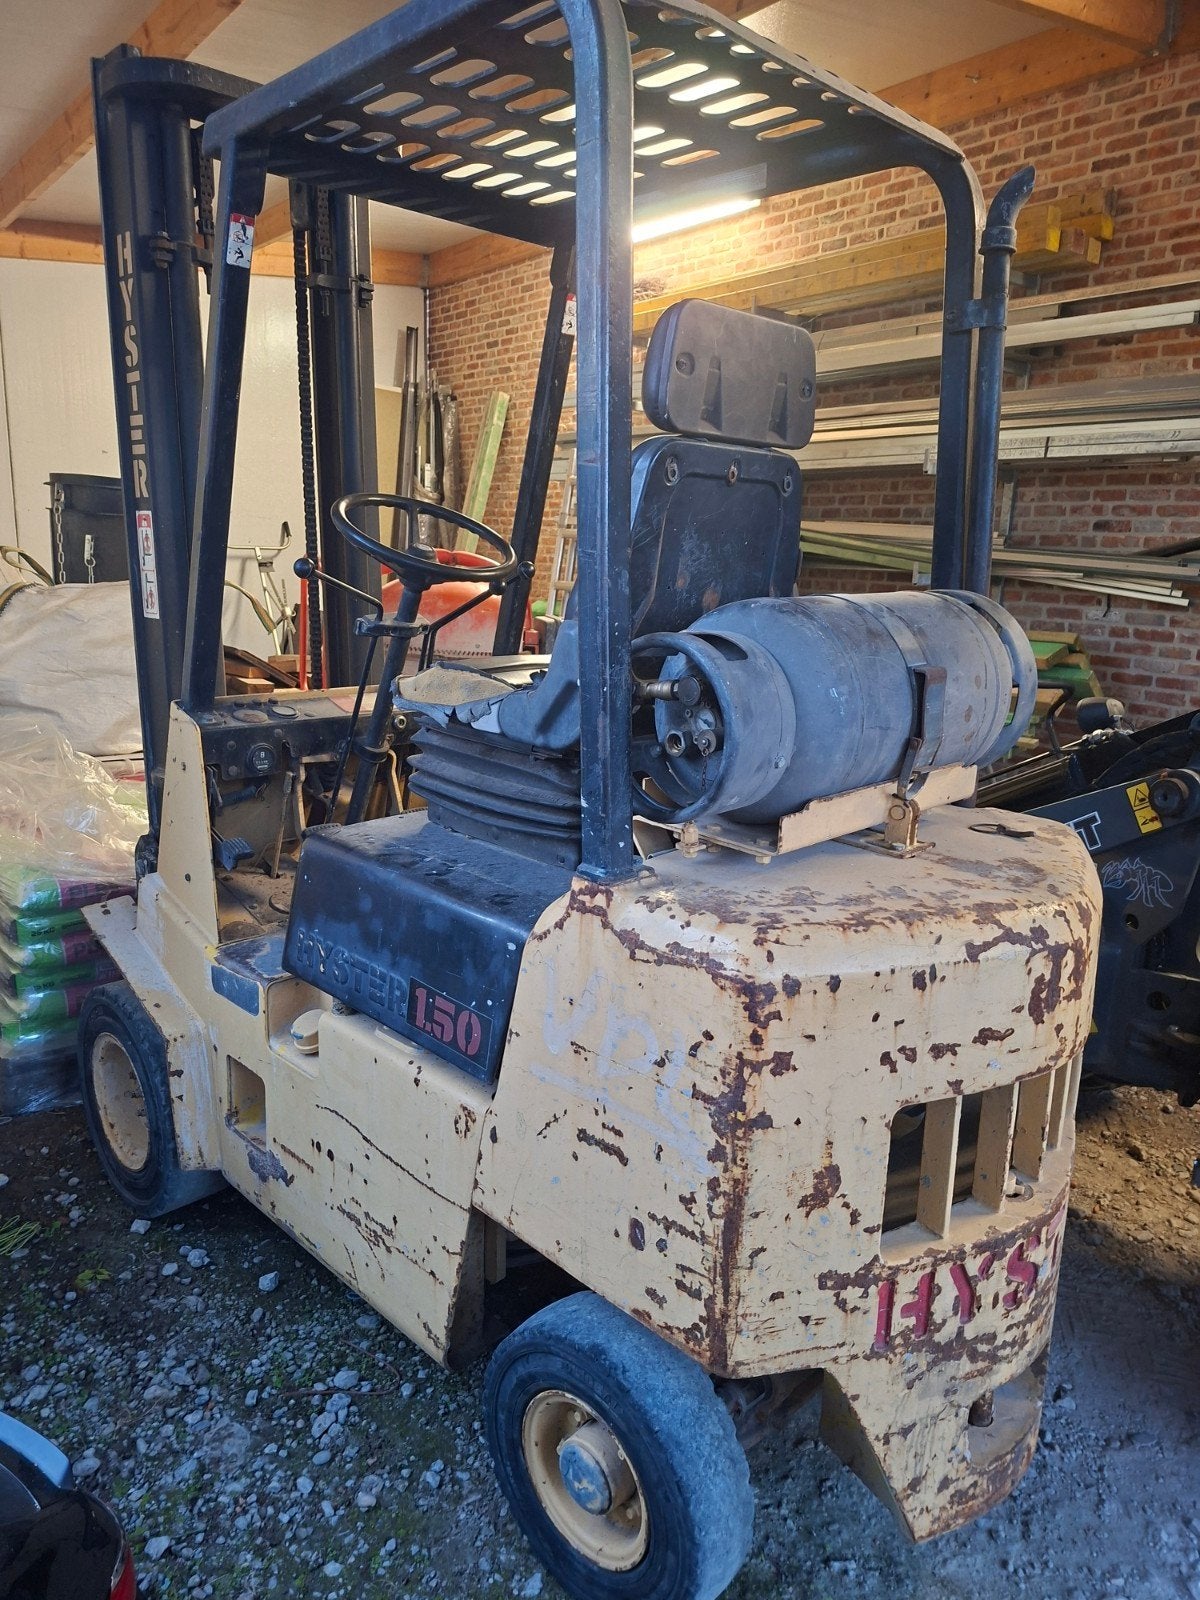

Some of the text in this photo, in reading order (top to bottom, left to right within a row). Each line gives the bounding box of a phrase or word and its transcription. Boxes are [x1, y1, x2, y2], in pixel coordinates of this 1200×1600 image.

[116, 231, 149, 498] HYSTER
[1064, 811, 1101, 850] T
[297, 928, 408, 1017] HYSTER
[415, 987, 482, 1056] 1.50
